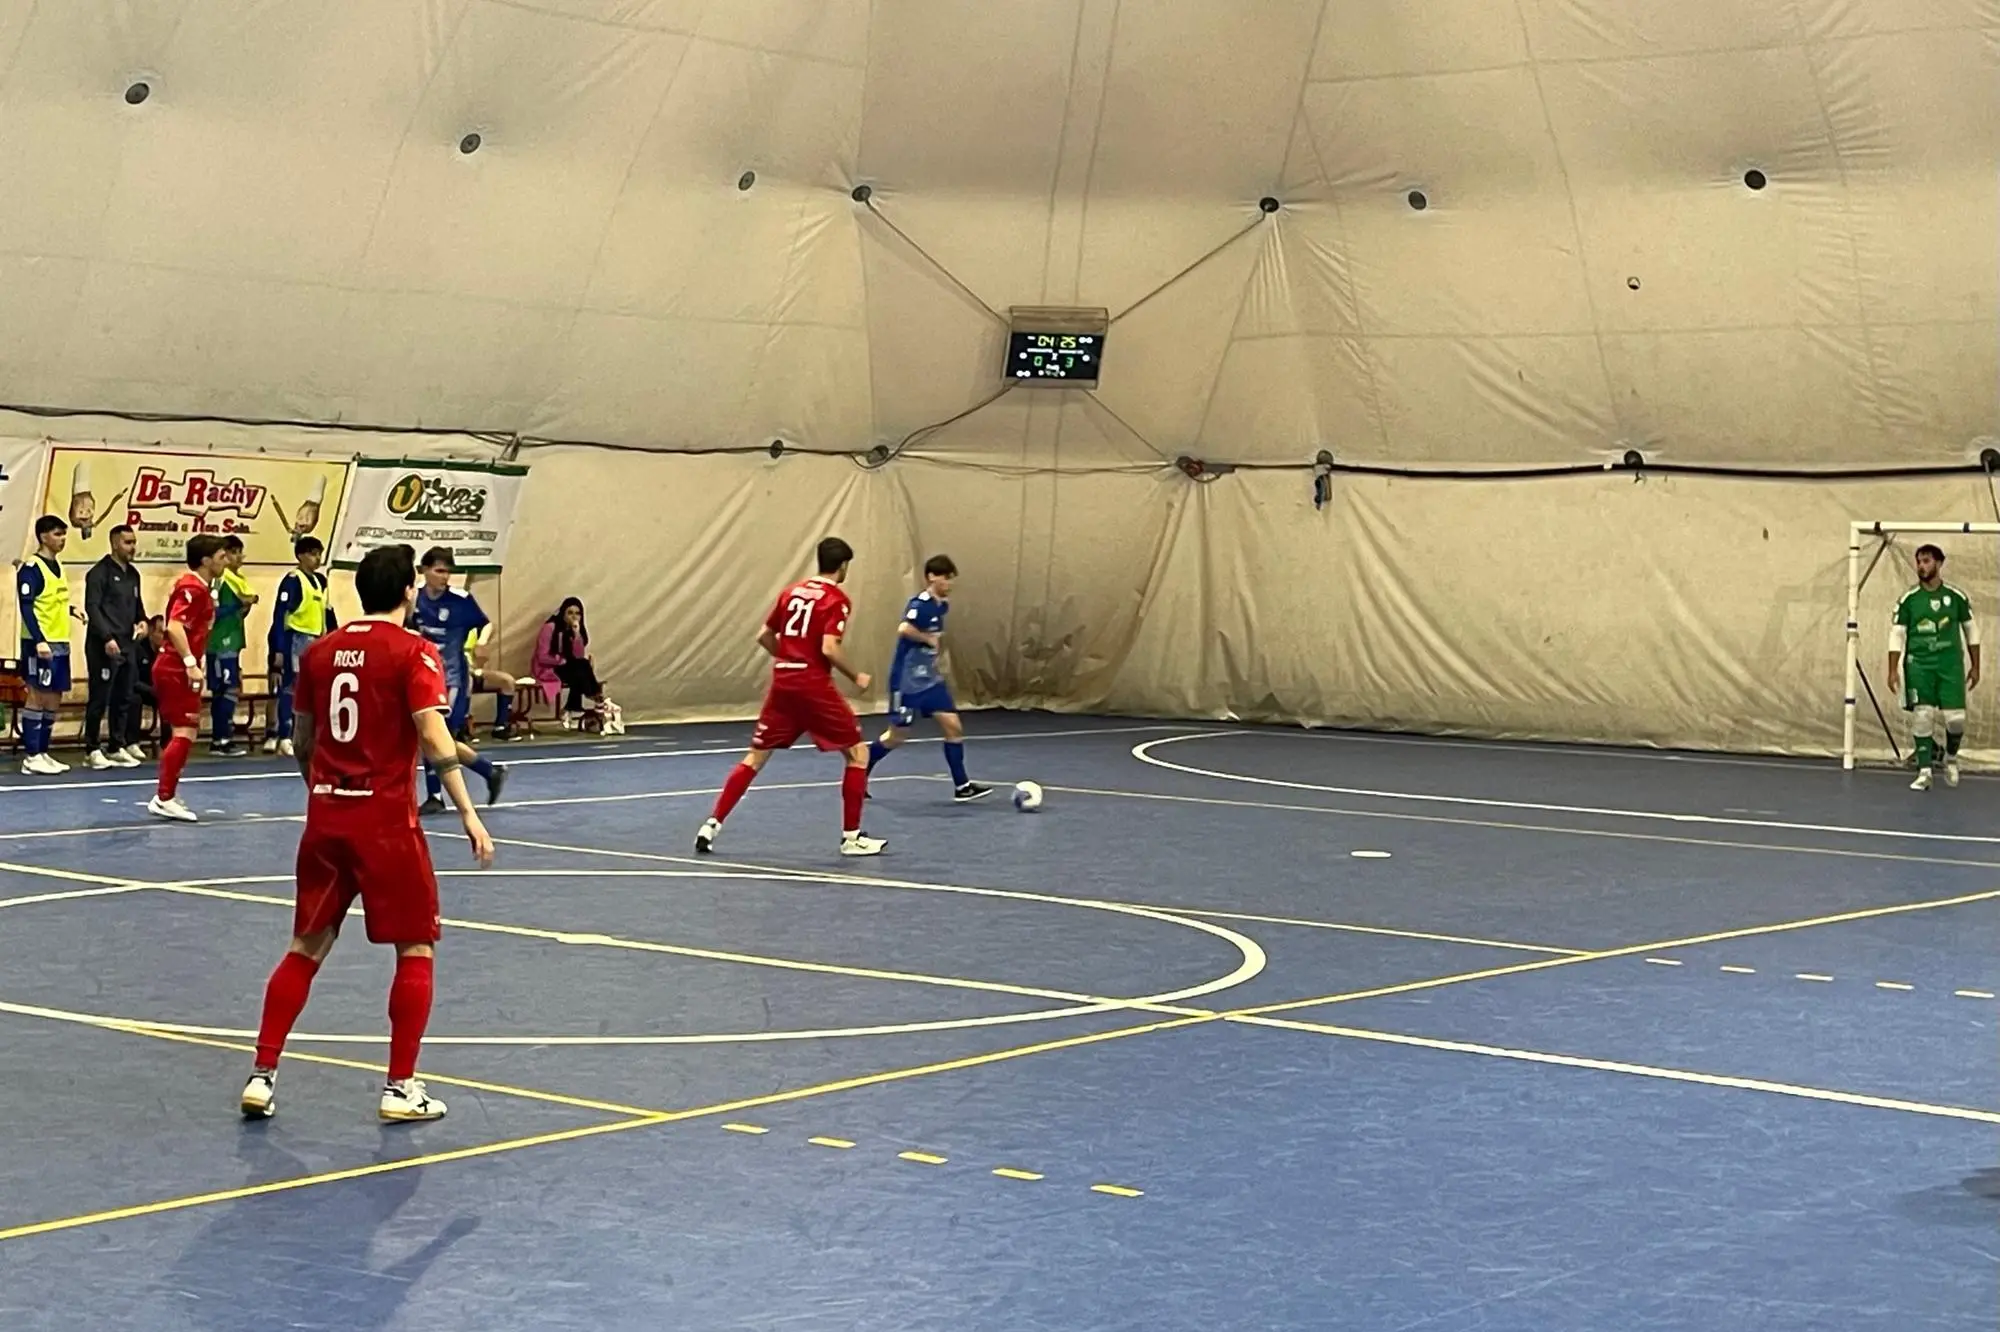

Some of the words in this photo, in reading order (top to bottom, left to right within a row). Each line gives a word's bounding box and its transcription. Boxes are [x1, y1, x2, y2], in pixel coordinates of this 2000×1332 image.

[136, 474, 172, 502] Da
[184, 477, 259, 509] Rachy
[784, 598, 815, 638] 21
[333, 650, 365, 667] ROSA
[329, 672, 359, 743] 6
